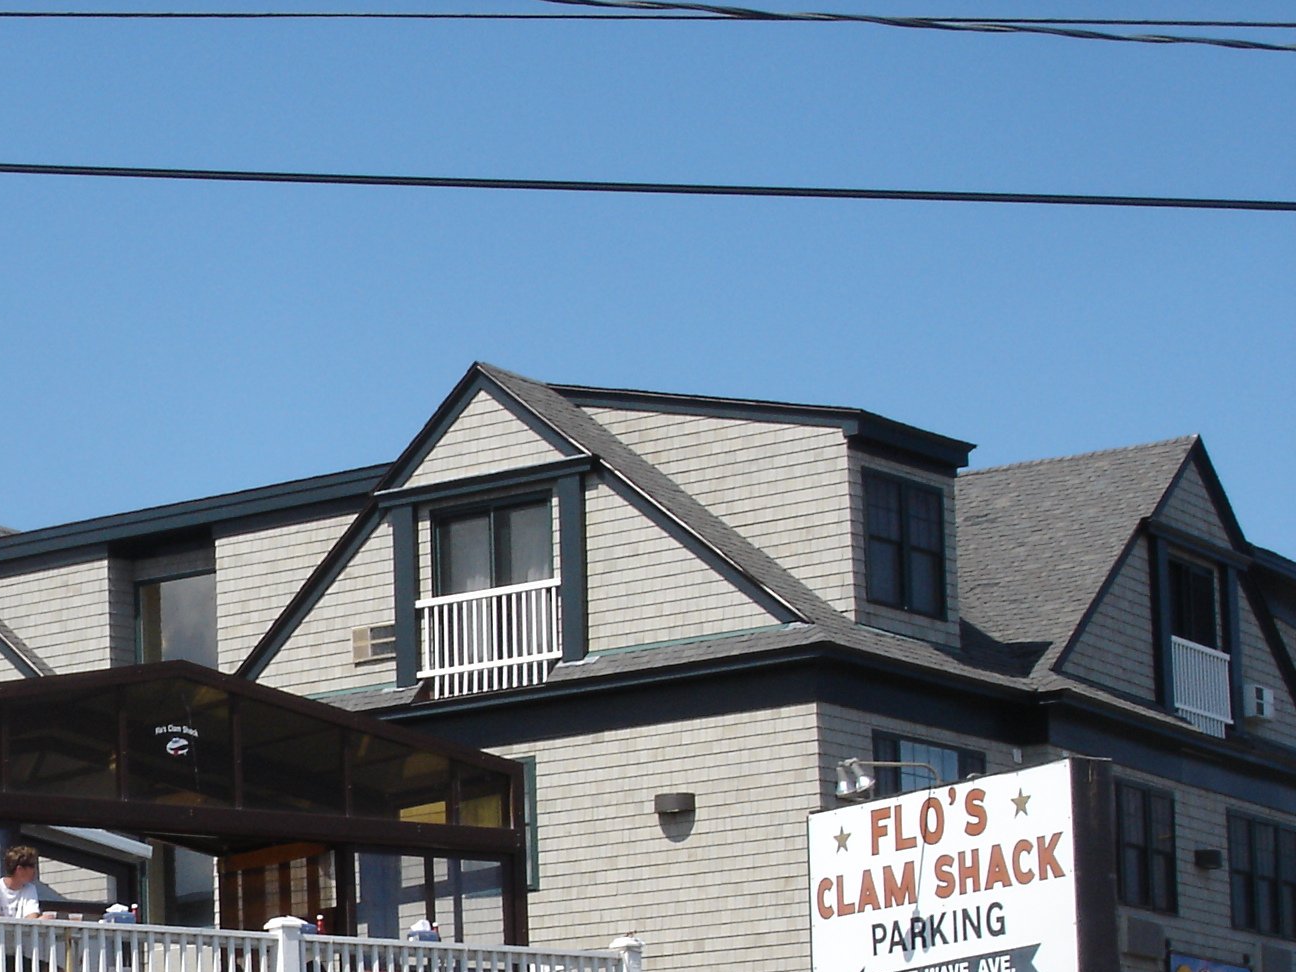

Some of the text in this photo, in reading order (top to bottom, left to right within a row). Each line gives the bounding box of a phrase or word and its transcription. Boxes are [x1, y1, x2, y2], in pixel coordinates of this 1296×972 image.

[869, 786, 988, 857] FLO'S
[816, 831, 1066, 920] CLAM SHACK
[871, 901, 1007, 956] PARKING
